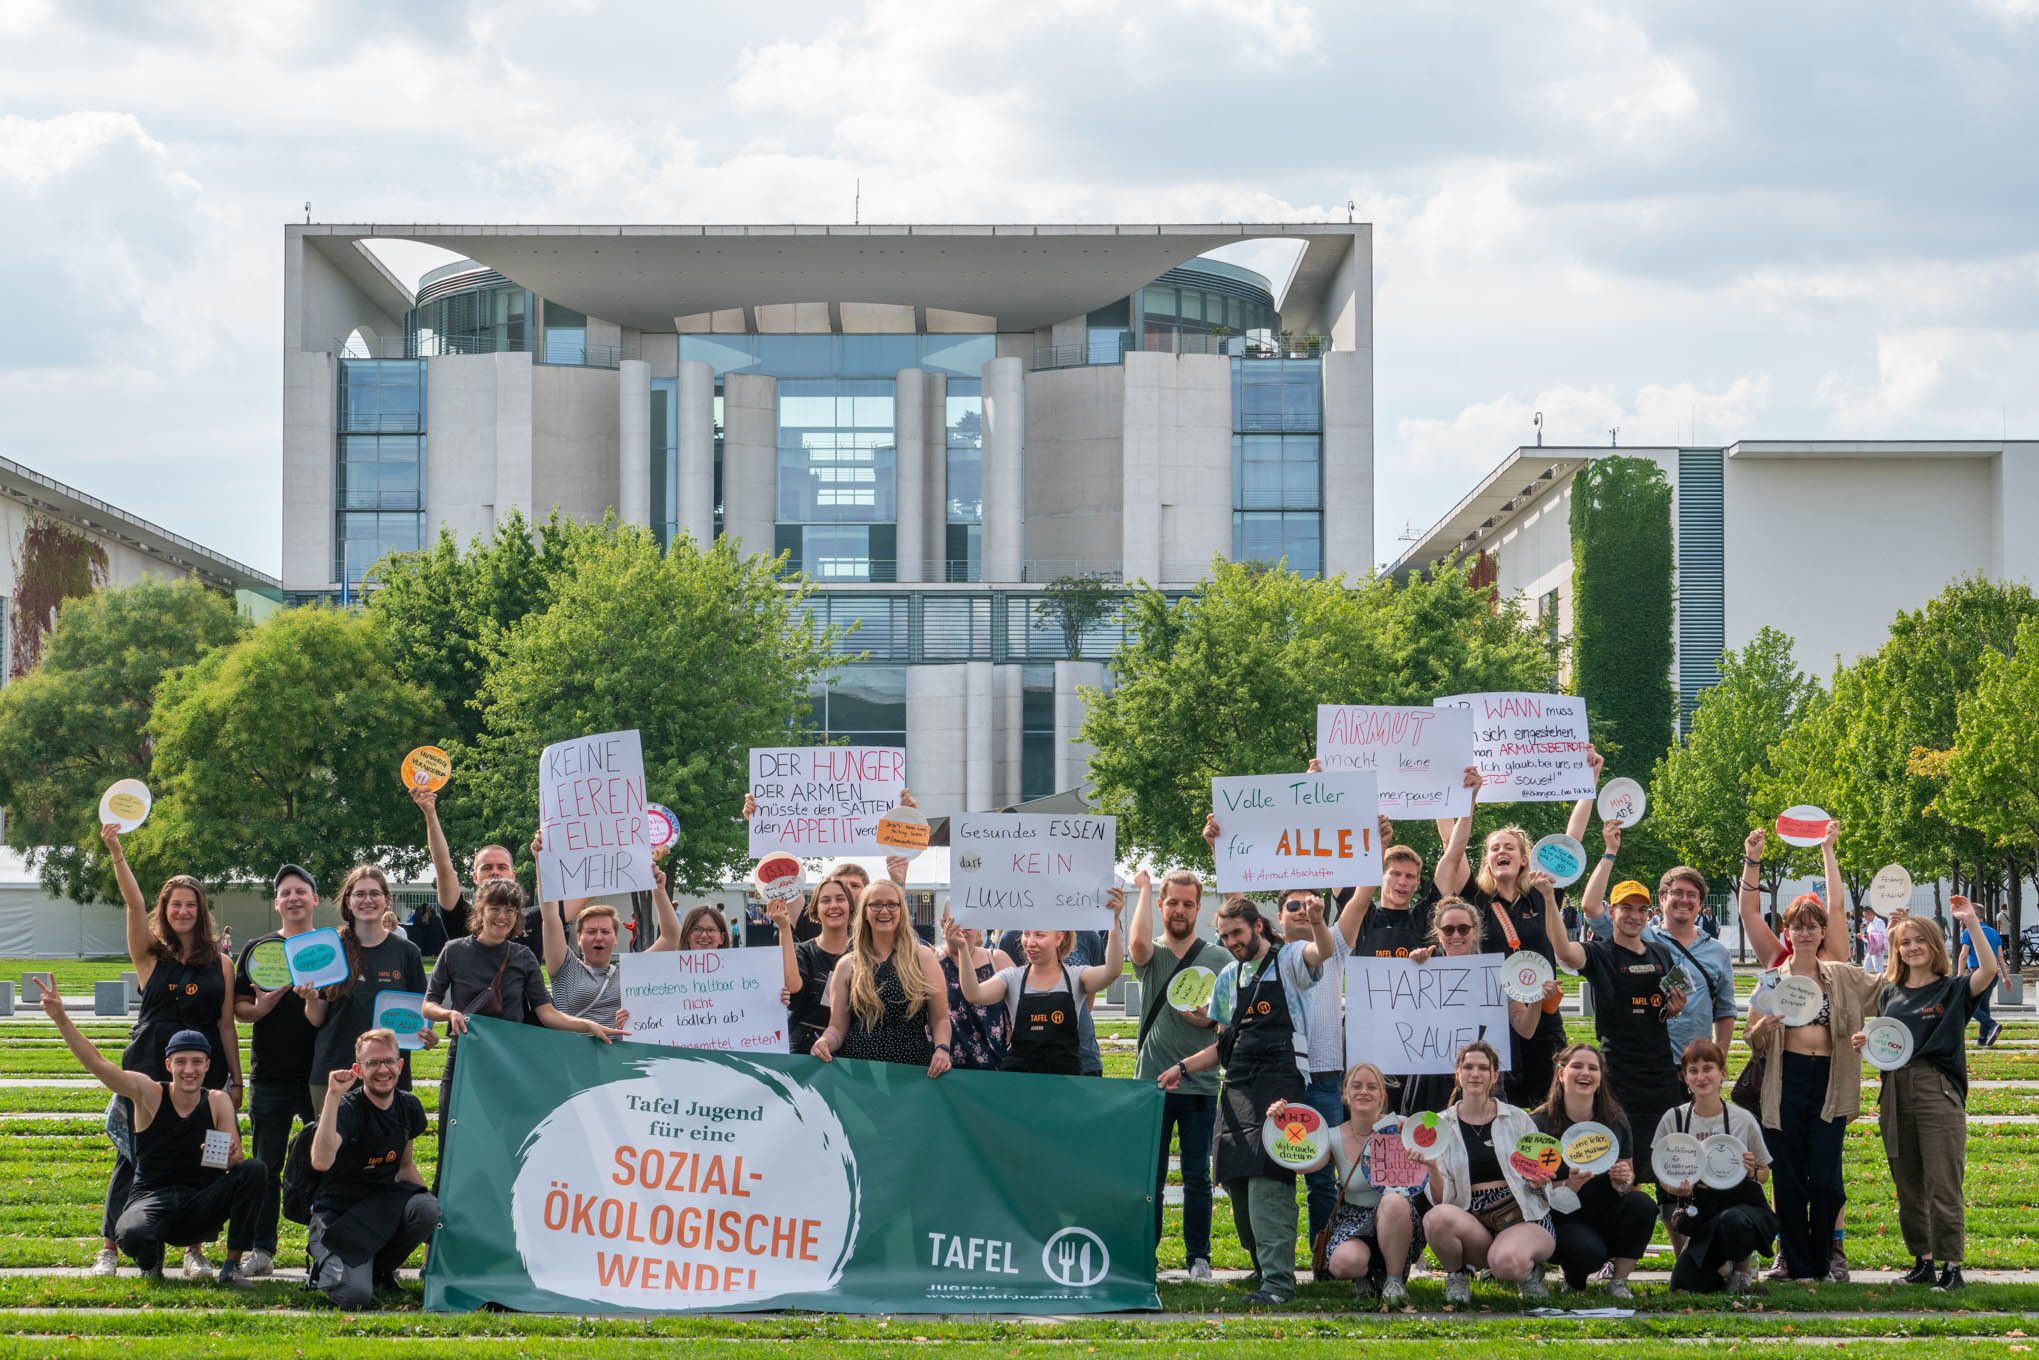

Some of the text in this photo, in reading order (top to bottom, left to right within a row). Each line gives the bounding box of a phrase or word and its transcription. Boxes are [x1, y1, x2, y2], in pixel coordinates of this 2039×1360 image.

[1484, 697, 1542, 719] WANN
[1546, 707, 1574, 716] muss
[1328, 709, 1436, 746] ARMUT
[1482, 725, 1507, 742] sich
[551, 740, 621, 779] KEINE
[760, 751, 905, 782] DER HUNGER
[1400, 752, 1431, 769] keine
[1556, 760, 1571, 769] uns
[1481, 773, 1512, 786] ETZT
[542, 776, 644, 822] LEEREN
[754, 783, 862, 802] DER ARMEN
[1222, 781, 1345, 812] Volle Teller
[1378, 786, 1451, 807] merpause!
[752, 800, 895, 817] müsste den SATTEN
[542, 817, 645, 852] TELLER
[754, 820, 781, 835] den
[779, 818, 861, 844] APPETIT
[961, 820, 1106, 841] Gesundes ESSEN
[1227, 827, 1370, 861] für ALLE!
[560, 851, 638, 894] MEHR
[960, 853, 1073, 875] darf KEIN
[965, 887, 1100, 910] LUXUS sein!
[679, 952, 725, 974] MHD:
[1520, 952, 1548, 969] TAFEL
[625, 977, 760, 998] mindestens haltbar bis
[1366, 966, 1504, 1010] HARTZ IV
[682, 997, 714, 1010] nicht
[1632, 997, 1649, 1005] TAFEL
[633, 1009, 745, 1031] sofort tödlich ab!
[1030, 1014, 1048, 1022] TAFEL
[740, 1030, 781, 1049] retten!
[626, 1094, 764, 1123] Tafel Jugend
[1278, 1112, 1312, 1122] MHD
[648, 1120, 736, 1143] für eine
[612, 1145, 763, 1198] SOZIAL-
[543, 1181, 822, 1262] ÖKOLOGISCHE
[928, 1232, 1020, 1275] TAFEL
